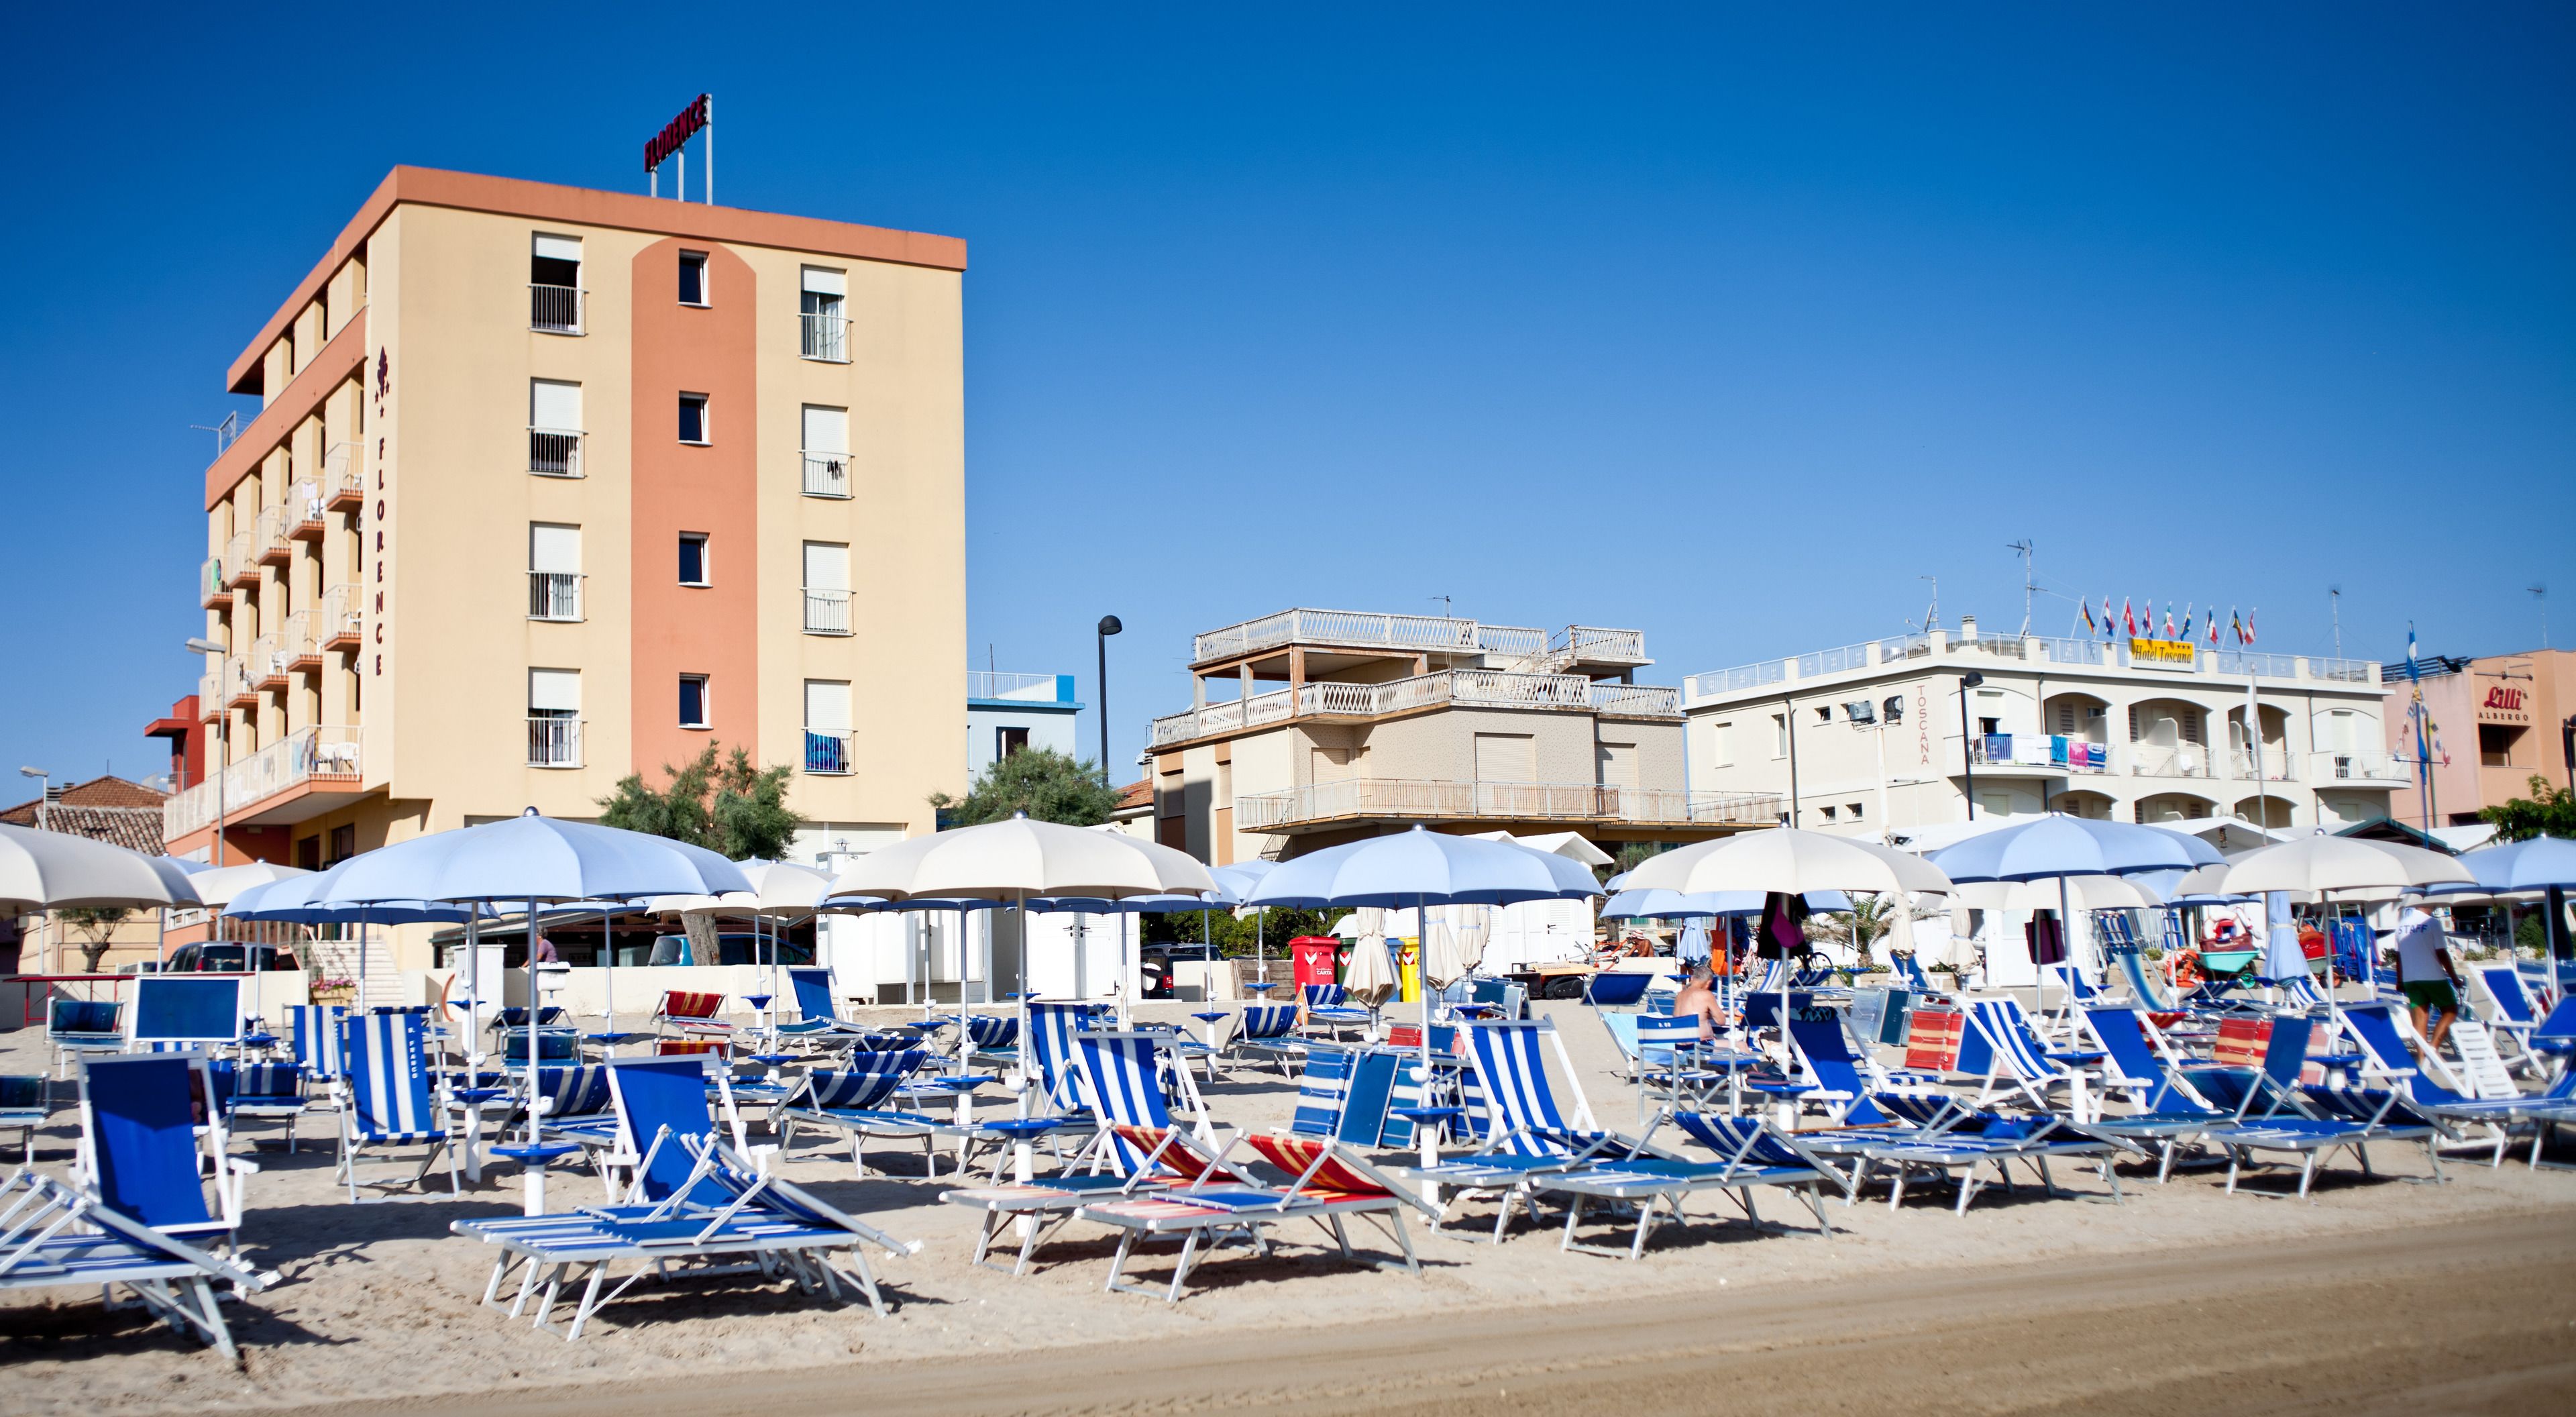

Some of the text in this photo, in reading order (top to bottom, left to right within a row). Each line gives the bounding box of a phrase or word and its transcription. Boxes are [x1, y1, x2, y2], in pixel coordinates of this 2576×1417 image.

[644, 93, 707, 173] FLORENCE
[375, 437, 385, 676] FLORENCE
[2135, 645, 2192, 664] Hotel Toscana
[2483, 686, 2522, 711] Lilli
[1917, 685, 1929, 765] TOSCANA
[2479, 712, 2528, 721] ALBERGO
[2398, 924, 2428, 935] STAFF
